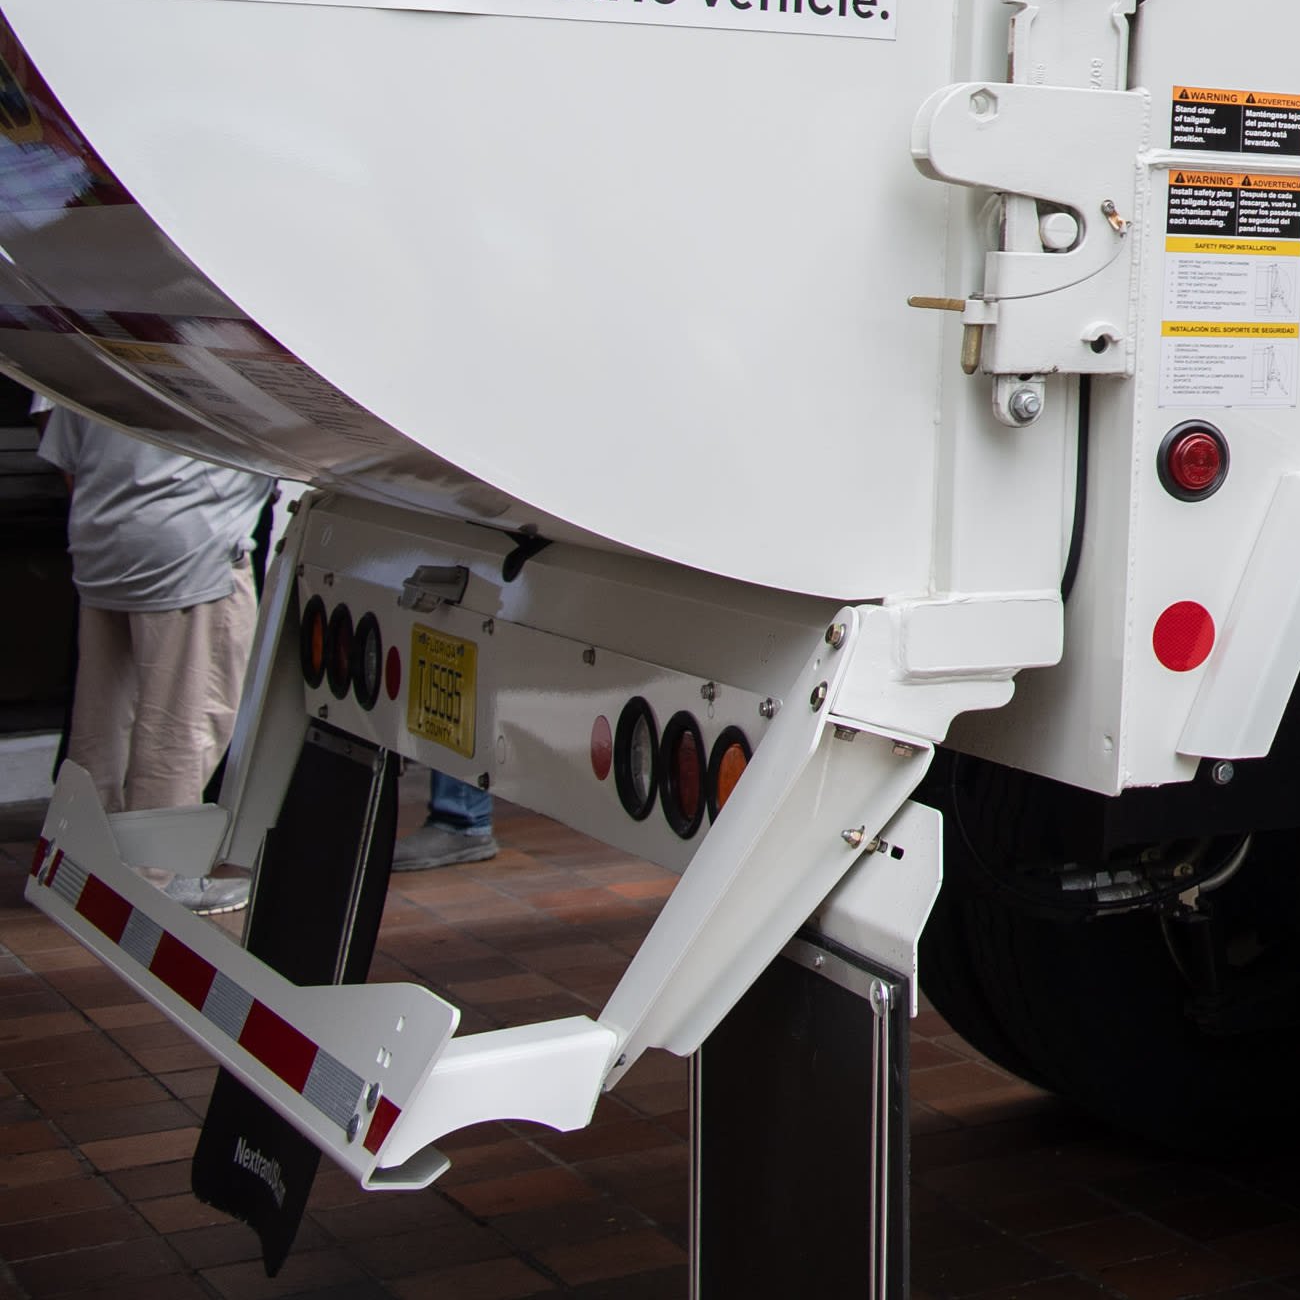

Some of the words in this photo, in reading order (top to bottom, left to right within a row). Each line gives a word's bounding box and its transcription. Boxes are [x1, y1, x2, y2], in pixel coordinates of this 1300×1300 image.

[1191, 92, 1237, 103] WARNING
[1175, 105, 1196, 114] Stand
[1198, 106, 1216, 115] clear
[1245, 109, 1287, 121] Manténgase
[1184, 116, 1210, 125] tailgate
[1258, 120, 1277, 129] panel
[1174, 125, 1194, 133] when
[1195, 125, 1202, 133] in
[1204, 126, 1226, 135] raised
[1244, 129, 1271, 137] cuando
[1272, 130, 1287, 139] está
[1174, 134, 1206, 144] position.
[1244, 138, 1280, 148] levantado.
[1187, 175, 1233, 186] WARNING
[1171, 187, 1192, 196] Install
[1194, 188, 1215, 198] safety
[1217, 190, 1232, 199] pins
[1182, 198, 1207, 207] tailgate
[1209, 199, 1235, 209] locking
[1170, 207, 1211, 216] mechanism
[1212, 208, 1228, 217] after
[1169, 217, 1187, 225] each
[1188, 218, 1225, 228] unloading.
[1195, 242, 1217, 250] SAFETY
[1236, 244, 1277, 252] INSTALLATION
[1170, 325, 1209, 333] INSTALACIÓN
[425, 637, 456, 657] FLORIDA
[425, 720, 451, 740] COUNTY
